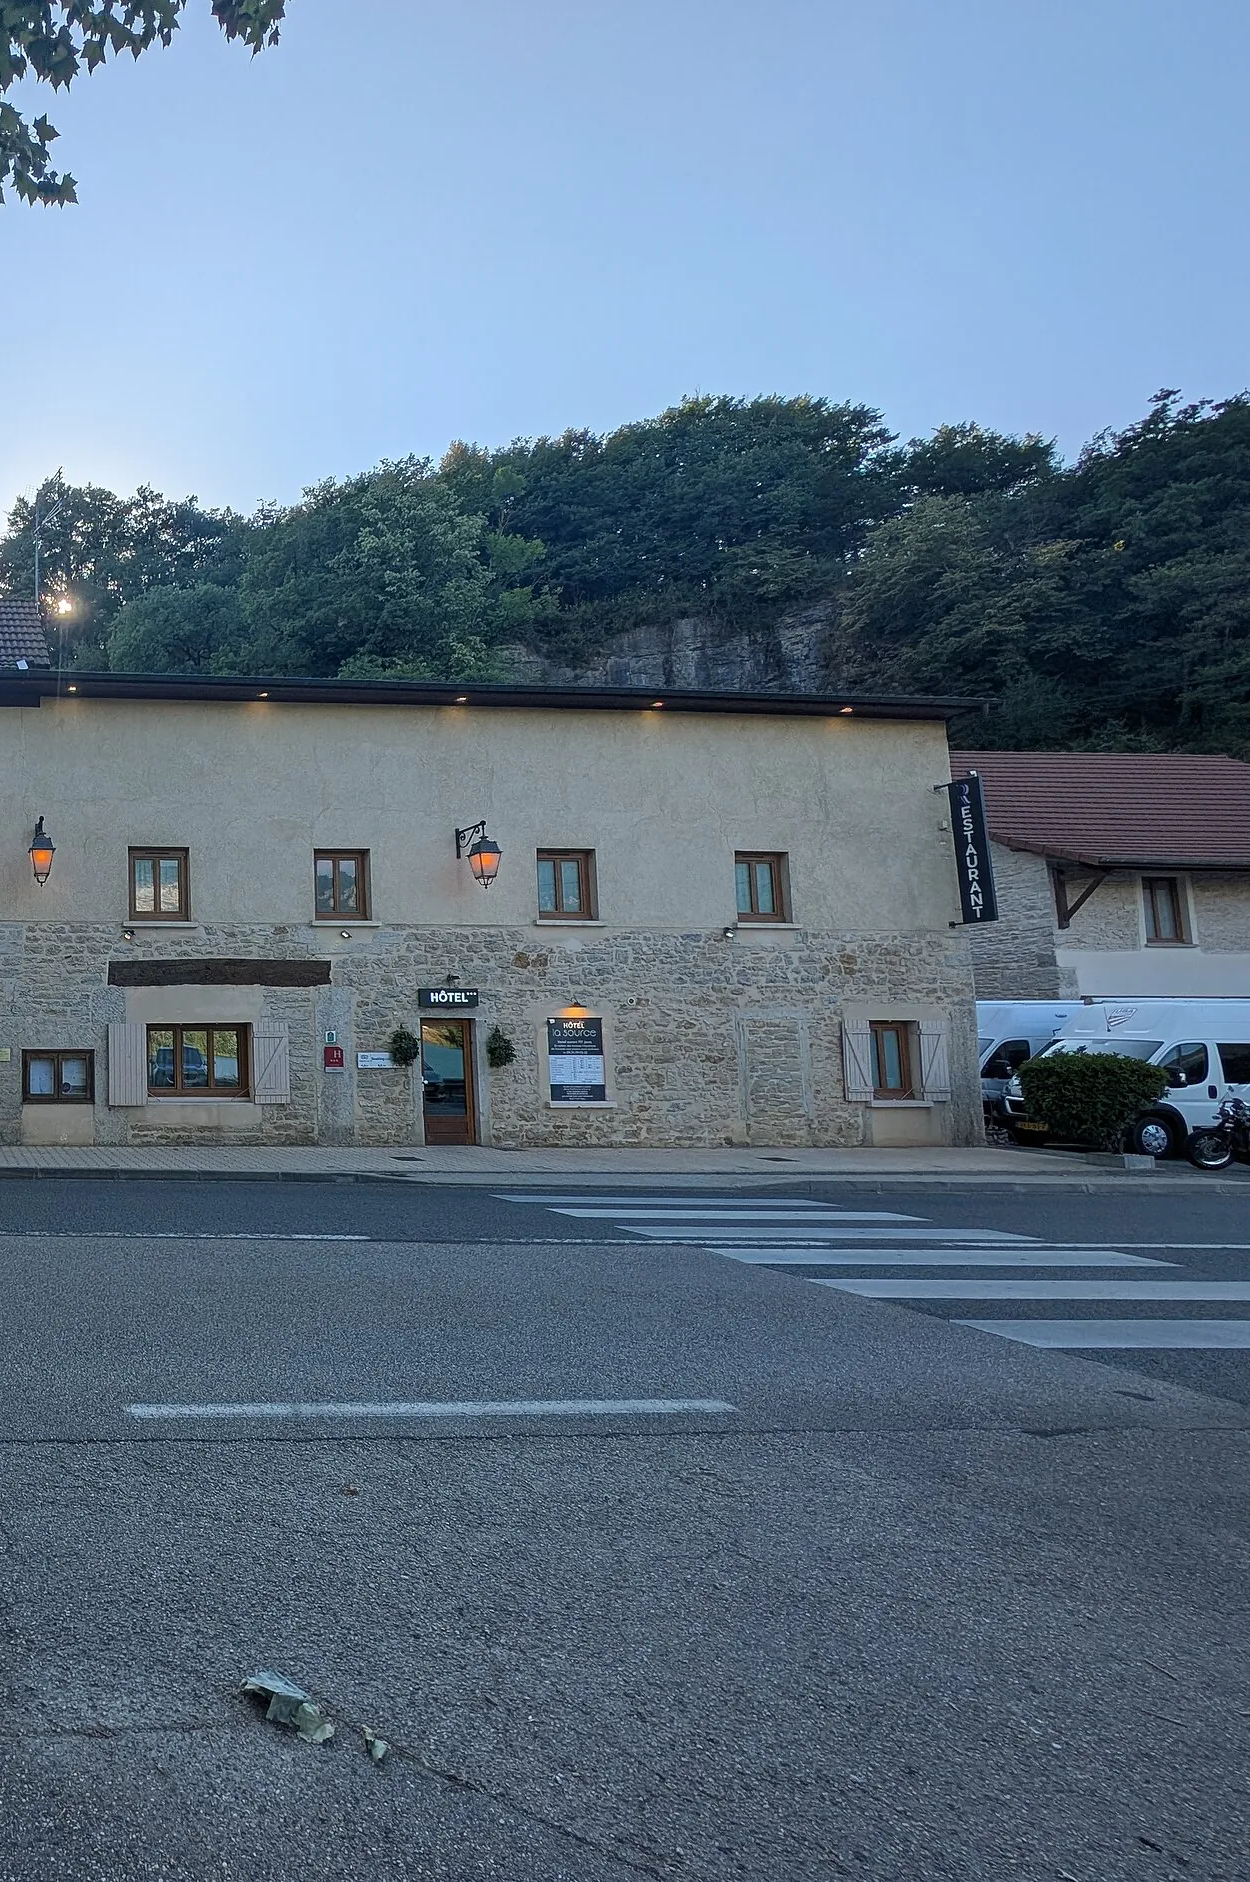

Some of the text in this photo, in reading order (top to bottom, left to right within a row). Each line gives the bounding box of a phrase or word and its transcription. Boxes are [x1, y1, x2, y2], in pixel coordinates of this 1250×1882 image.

[430, 989, 469, 1003] HÔTEL
[563, 1021, 585, 1029] HÔTEL
[552, 1028, 597, 1037] la source
[333, 1050, 341, 1058] H
